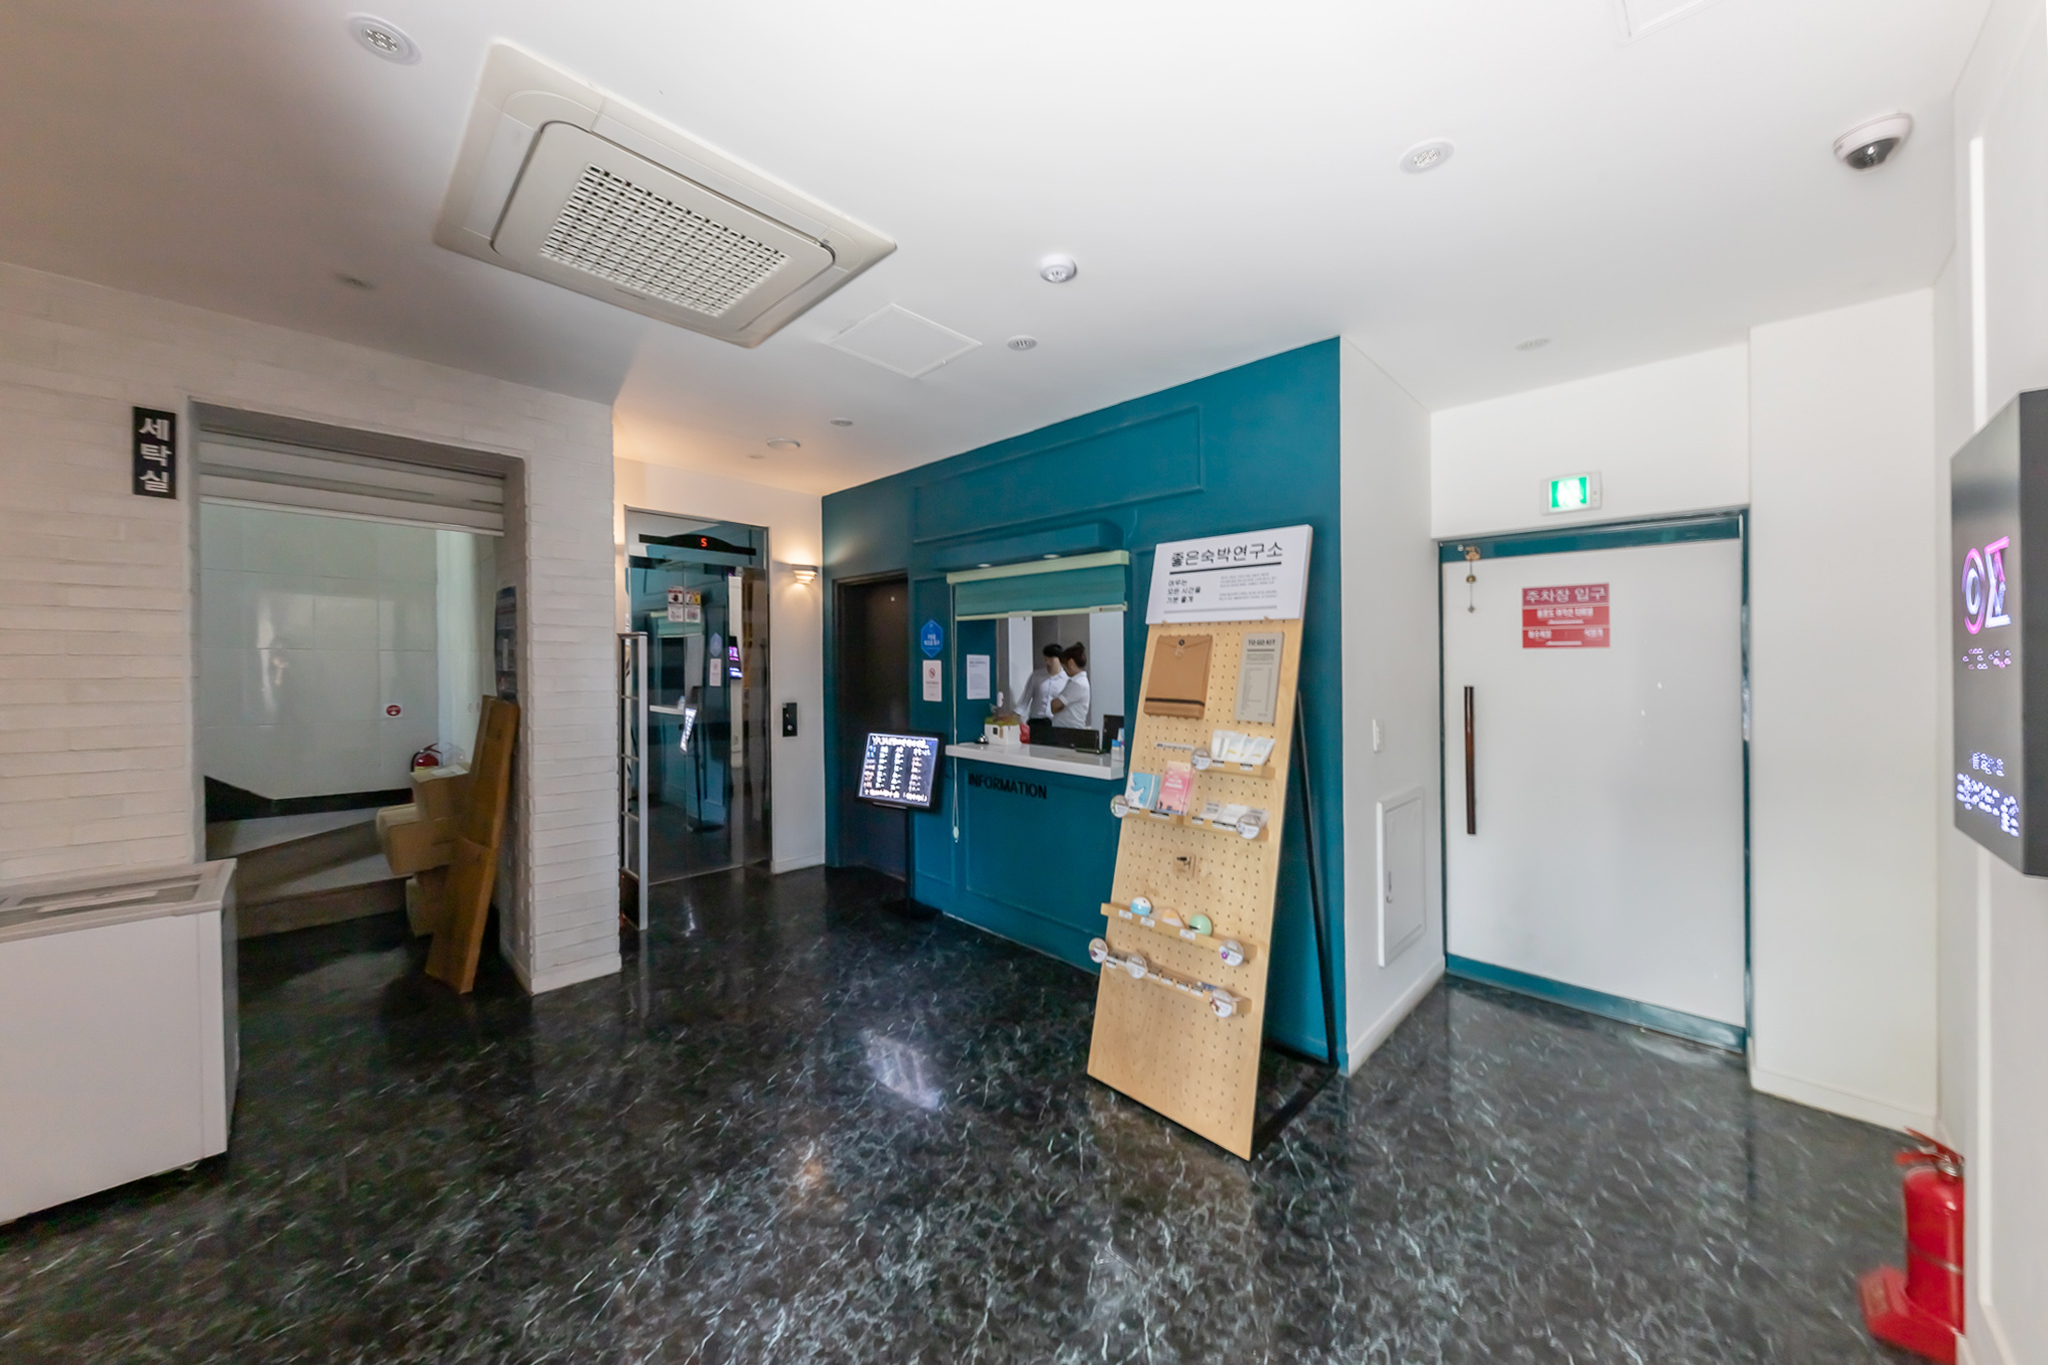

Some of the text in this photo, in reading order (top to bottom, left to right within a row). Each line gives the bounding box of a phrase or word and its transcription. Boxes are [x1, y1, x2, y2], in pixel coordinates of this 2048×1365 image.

[138, 417, 172, 493] 세탁실
[1171, 541, 1283, 567] 좋은숙박연구소
[1526, 587, 1607, 603] 주차장 입구
[968, 772, 1048, 799] INFORMATION
